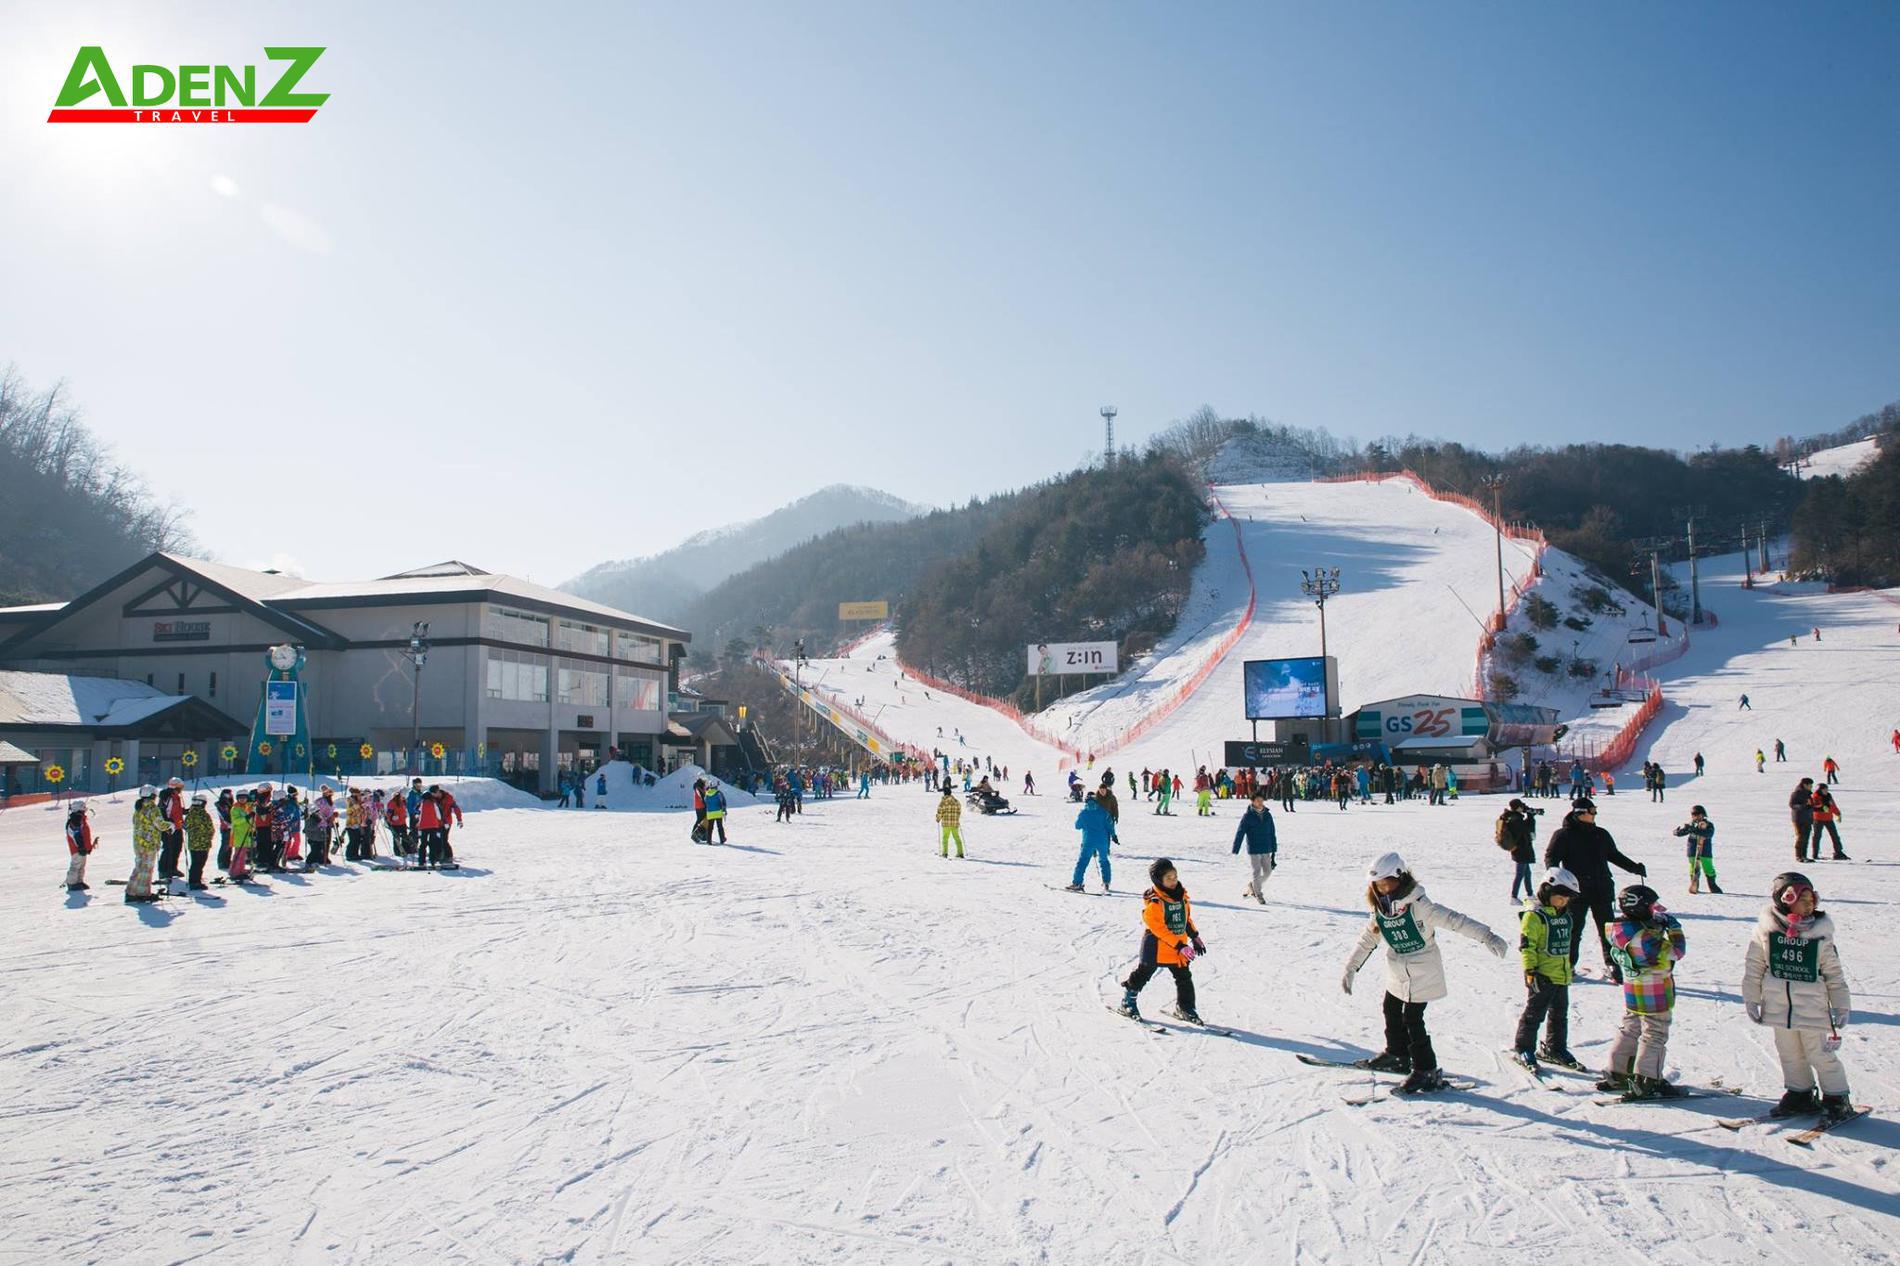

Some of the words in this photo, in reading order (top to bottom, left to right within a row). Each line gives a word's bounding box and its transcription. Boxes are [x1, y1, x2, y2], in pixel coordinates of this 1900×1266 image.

[1386, 707, 1456, 738] GS25
[1383, 917, 1406, 929] GROUP
[1391, 930, 1409, 942] 308
[1777, 935, 1809, 947] GROUP
[1781, 949, 1803, 963] 496
